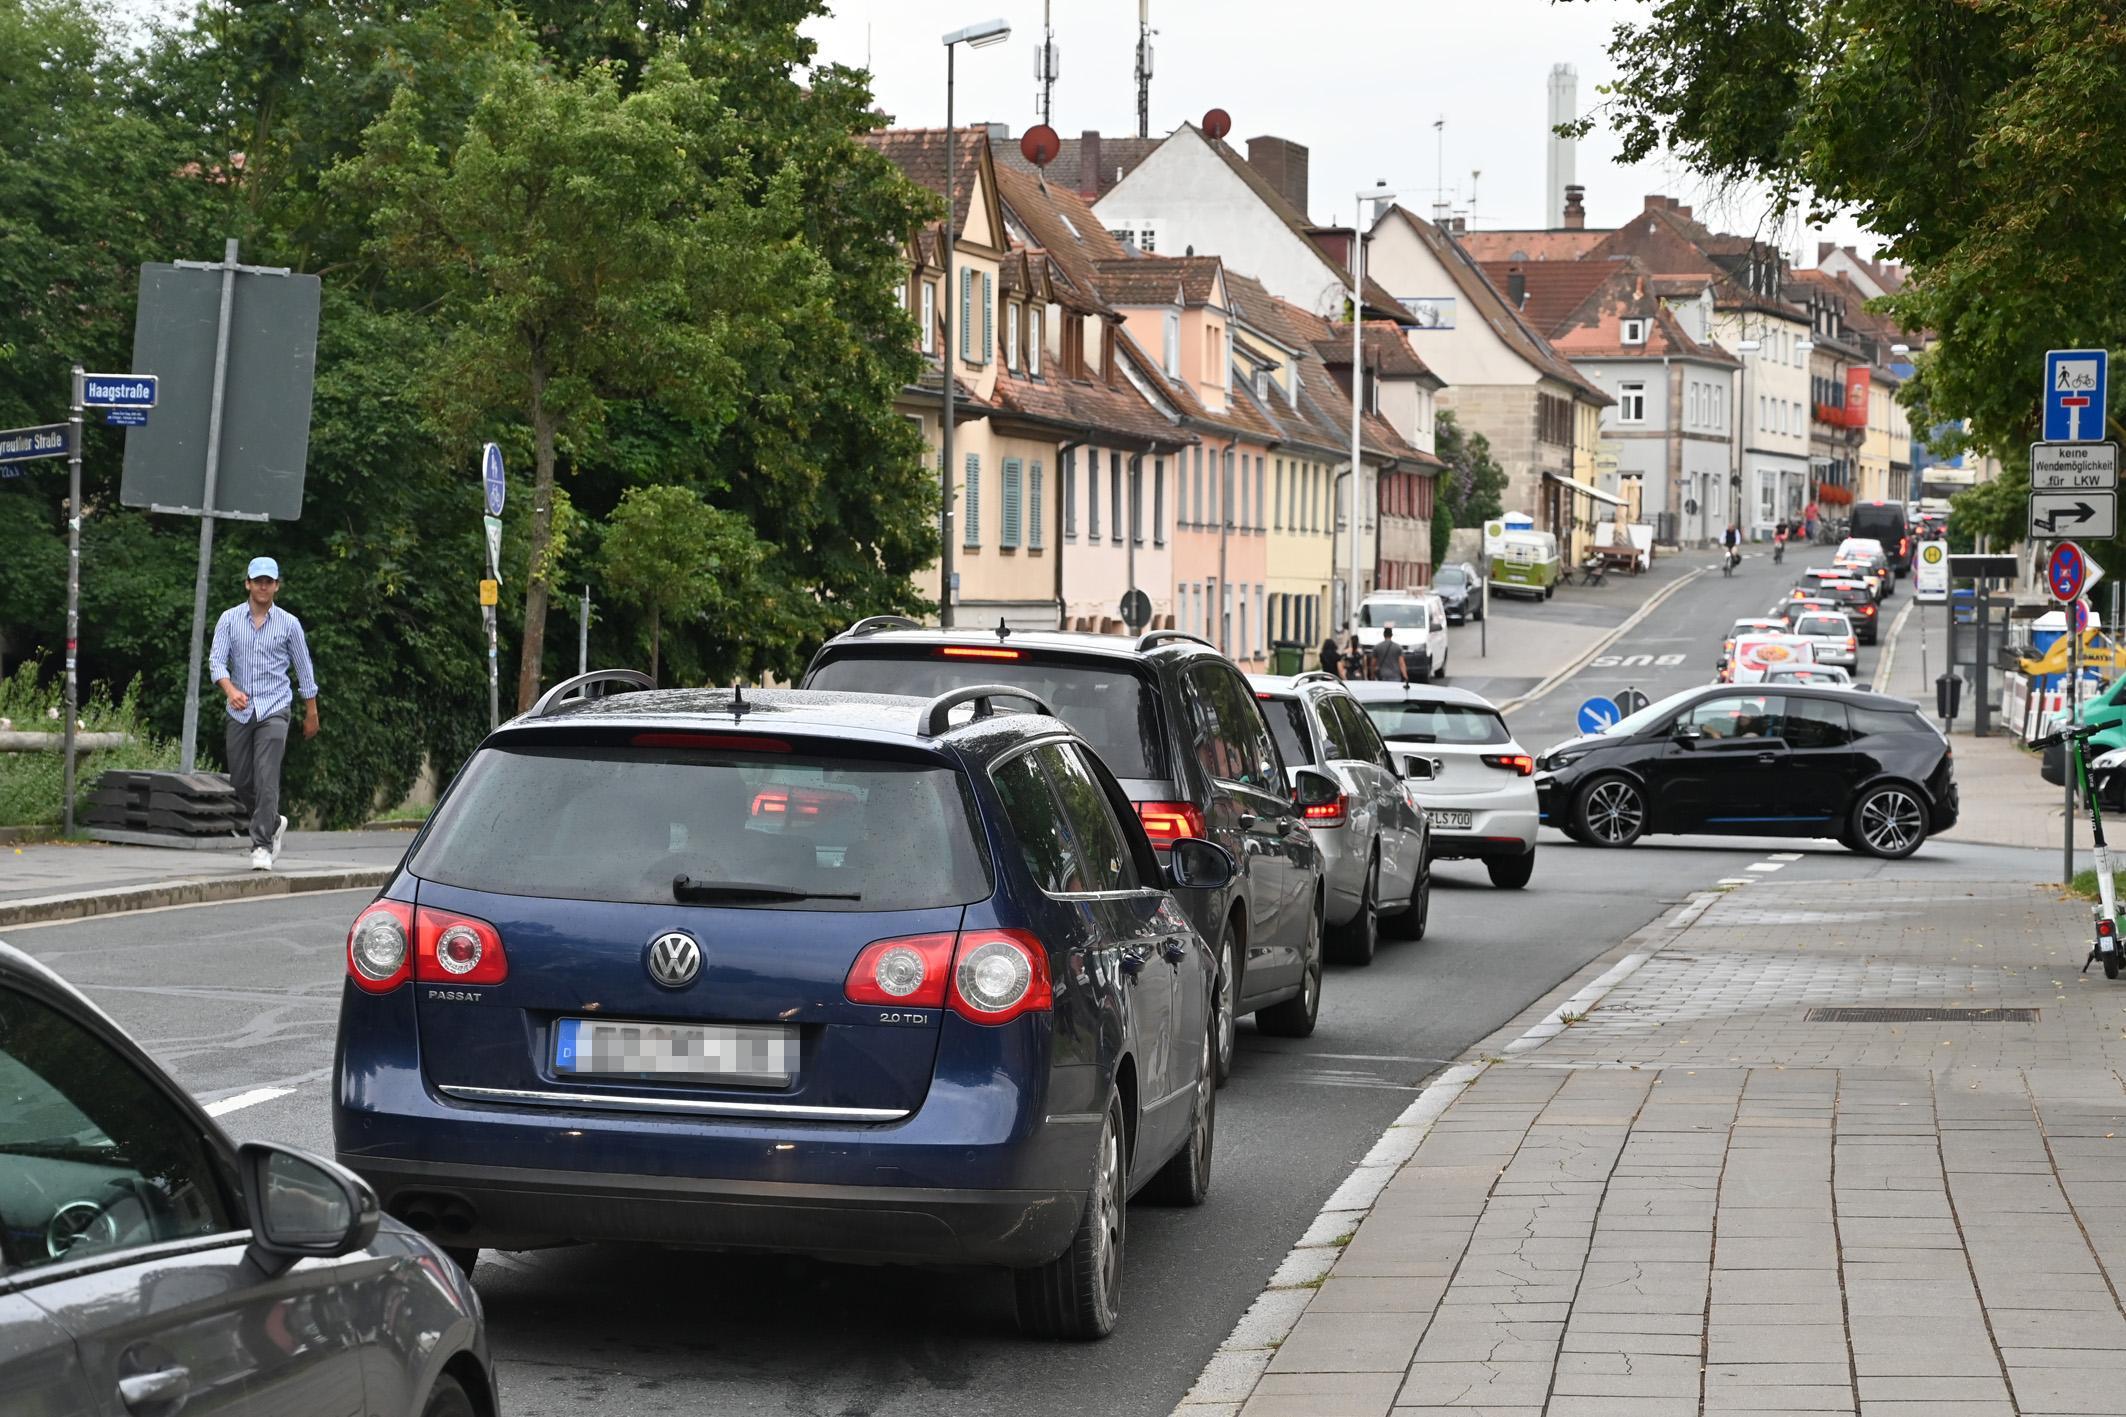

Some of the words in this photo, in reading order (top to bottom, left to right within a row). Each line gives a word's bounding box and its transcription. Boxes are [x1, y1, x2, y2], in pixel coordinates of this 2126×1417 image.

[89, 382, 150, 401] Haagstraße
[34, 432, 62, 450] Straße
[2059, 448, 2088, 458] keine
[2036, 460, 2113, 473] Wendemöglichkeit
[2049, 475, 2064, 486] für
[2074, 475, 2100, 486] LKW
[1435, 812, 1449, 825] LS
[1451, 813, 1470, 825] 700
[428, 990, 482, 1002] PASSAT
[903, 1014, 928, 1025] TDI
